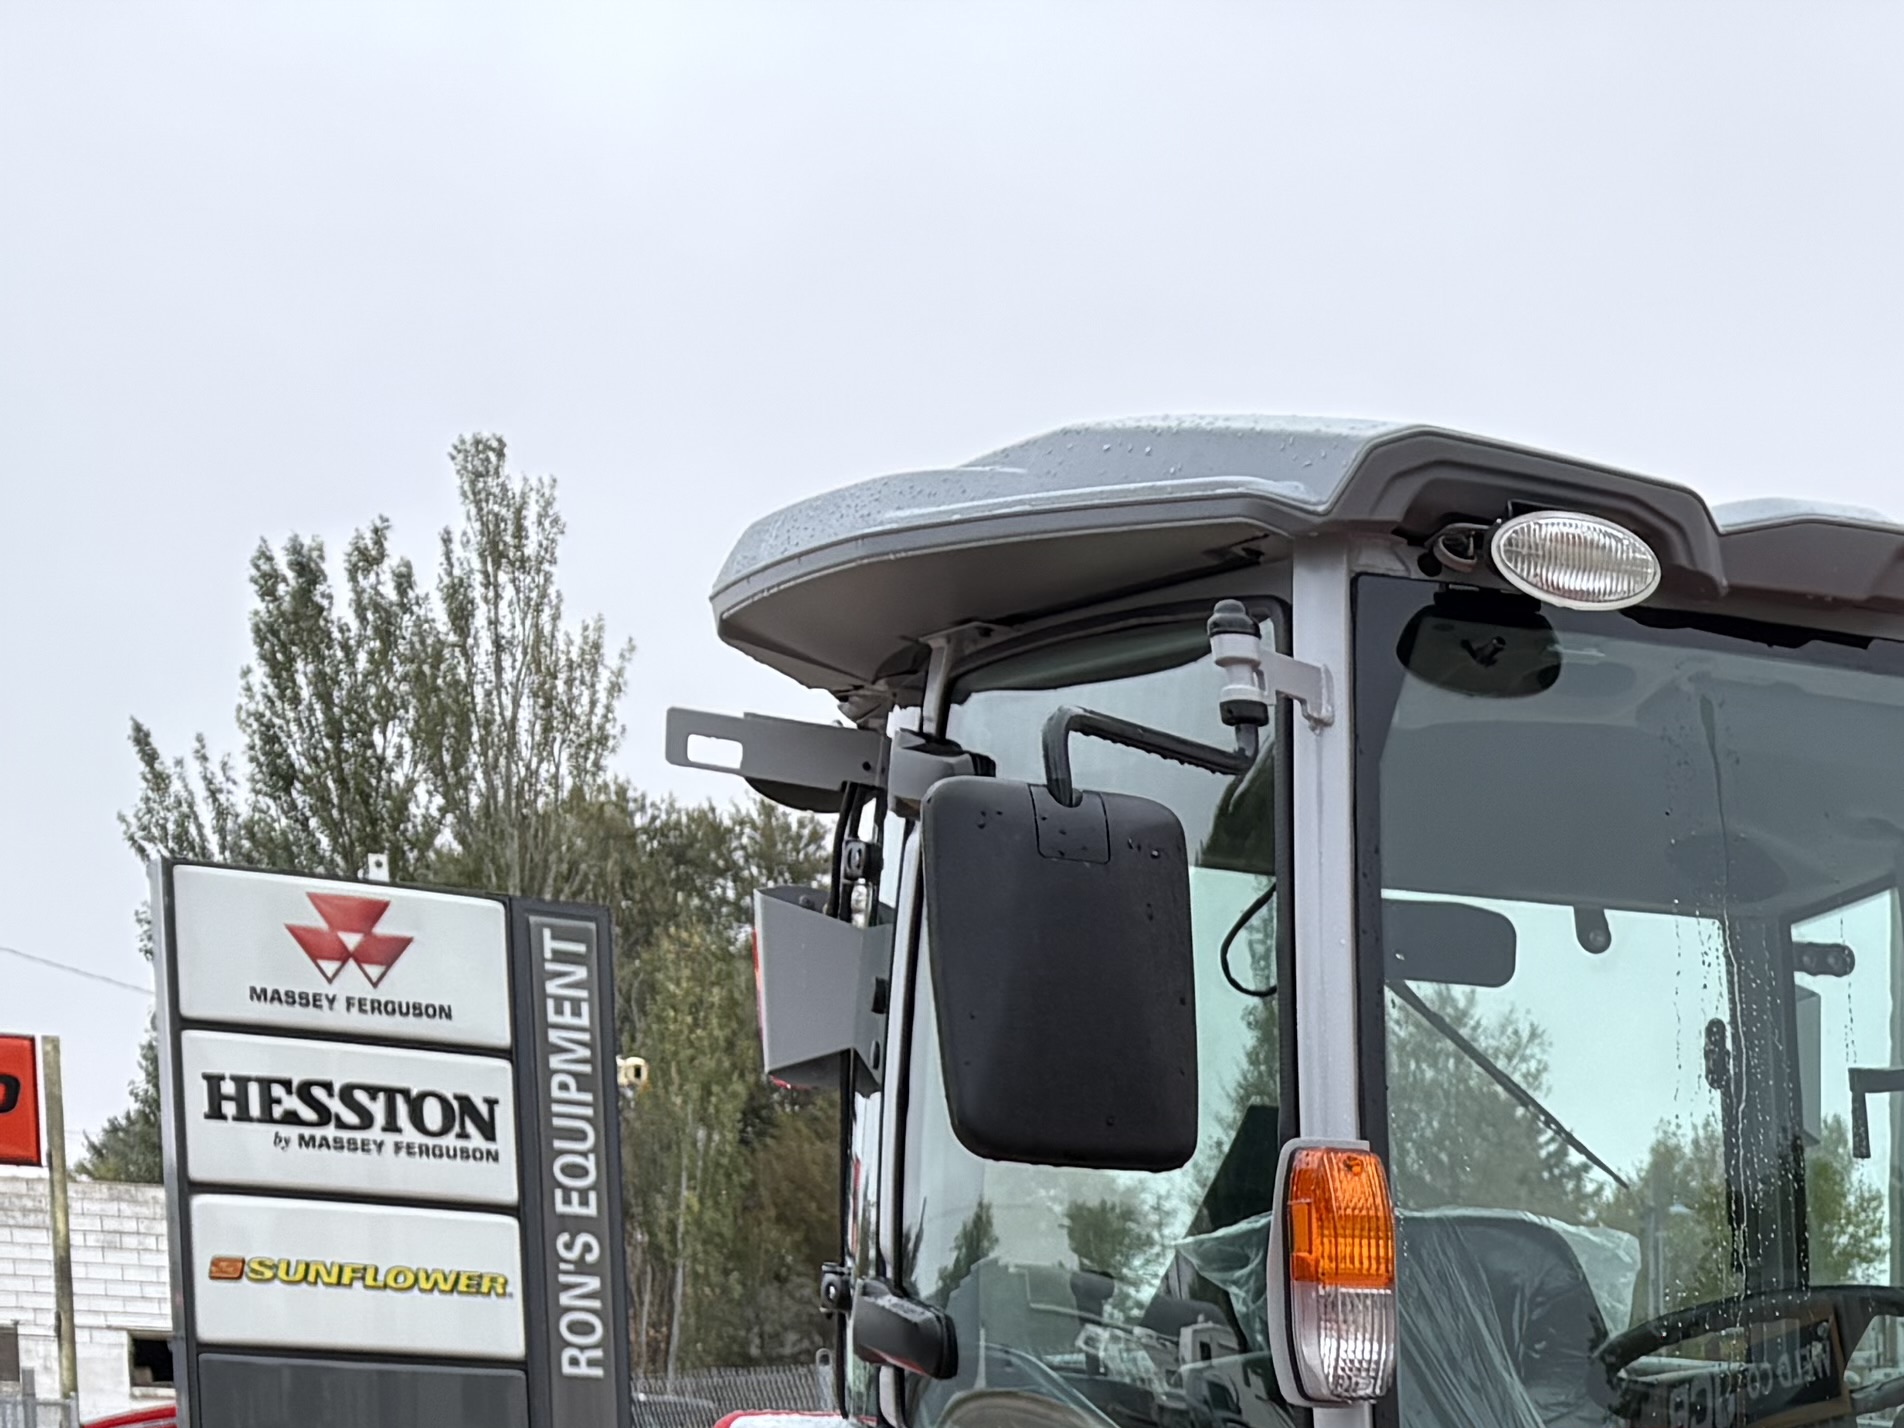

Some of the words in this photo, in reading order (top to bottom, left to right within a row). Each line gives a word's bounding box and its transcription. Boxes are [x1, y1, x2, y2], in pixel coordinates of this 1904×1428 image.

[249, 986, 337, 1012] MASSEY
[346, 997, 453, 1020] FERGUSON
[543, 928, 598, 1217] EQUIPMENT
[201, 1071, 499, 1142] HESSTON
[273, 1131, 291, 1150] by
[298, 1133, 385, 1155] MASSEY
[394, 1141, 499, 1163] FERGUSON
[245, 1256, 508, 1296] SUNFLOWER
[556, 1231, 604, 1379] RON'S
